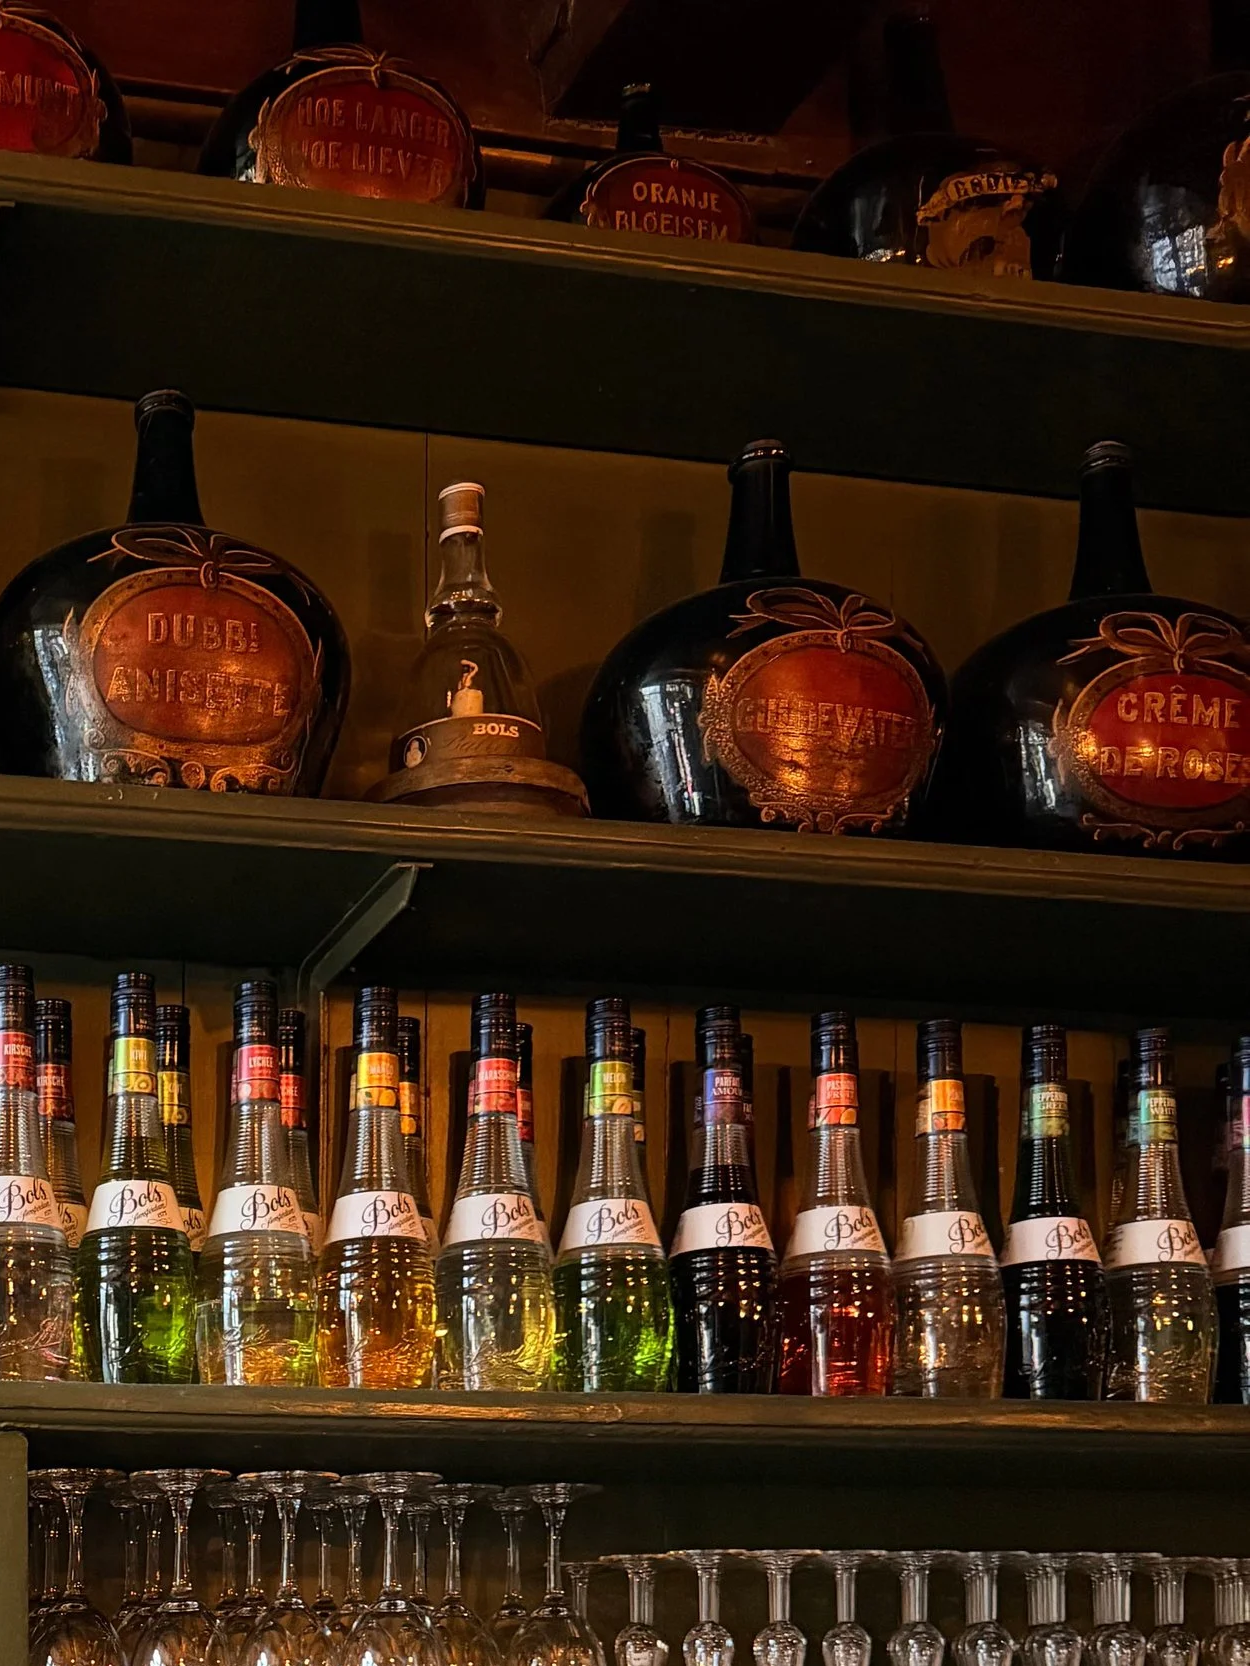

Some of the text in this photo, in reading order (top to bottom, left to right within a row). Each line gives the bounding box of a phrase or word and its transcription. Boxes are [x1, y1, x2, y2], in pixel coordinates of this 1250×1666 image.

[355, 102, 450, 147] LANGER
[632, 181, 722, 213] ORANJE
[106, 666, 291, 717] ANISETTE
[1117, 684, 1243, 729] CRÊME
[472, 722, 520, 738] BOLS
[1100, 746, 1146, 777] DE
[3, 1043, 33, 1058] KIRSCHE
[107, 1182, 163, 1227] Bols
[240, 1187, 292, 1231] Bols
[360, 1192, 411, 1236] Bols
[481, 1197, 530, 1240] Bols
[585, 1201, 641, 1244] Bols
[715, 1204, 762, 1247] Bols
[823, 1207, 872, 1250] Bols
